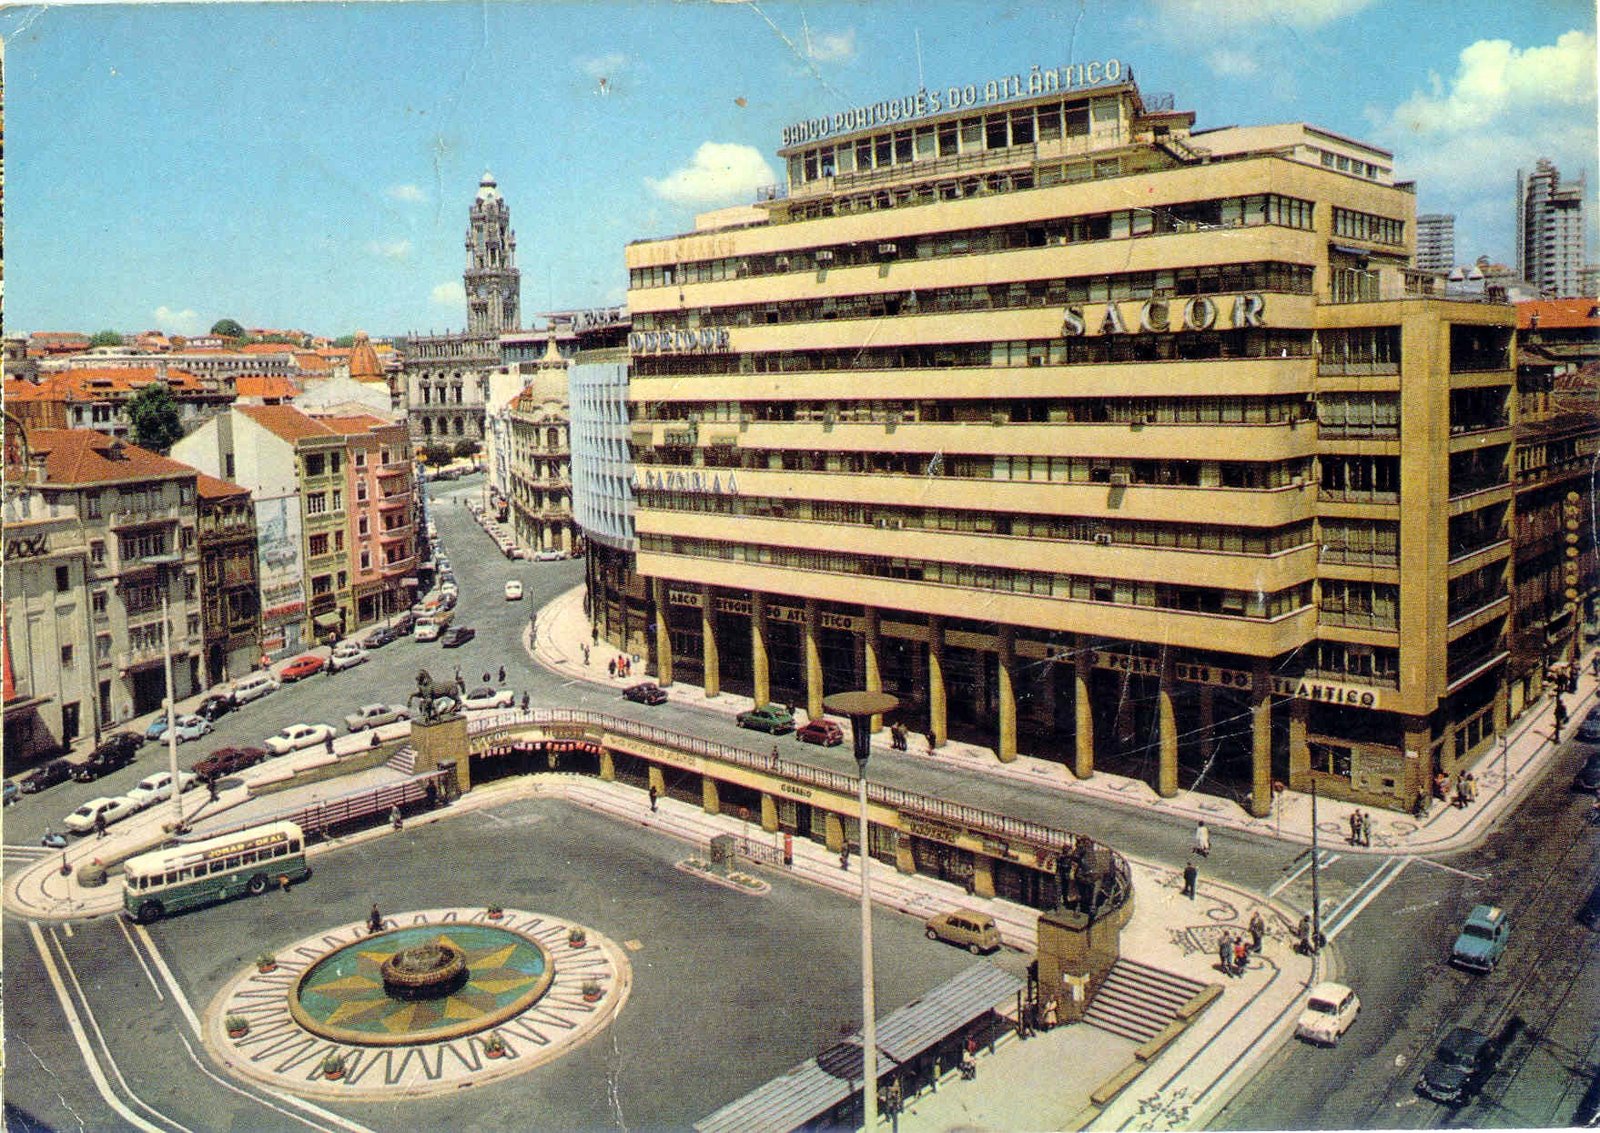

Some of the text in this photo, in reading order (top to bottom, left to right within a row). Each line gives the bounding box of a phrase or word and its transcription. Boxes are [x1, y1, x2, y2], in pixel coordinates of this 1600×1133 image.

[782, 115, 829, 144] BANCO
[949, 85, 977, 109] DO
[1061, 293, 1267, 338] SACOR
[1273, 679, 1375, 707] TLANTICO
